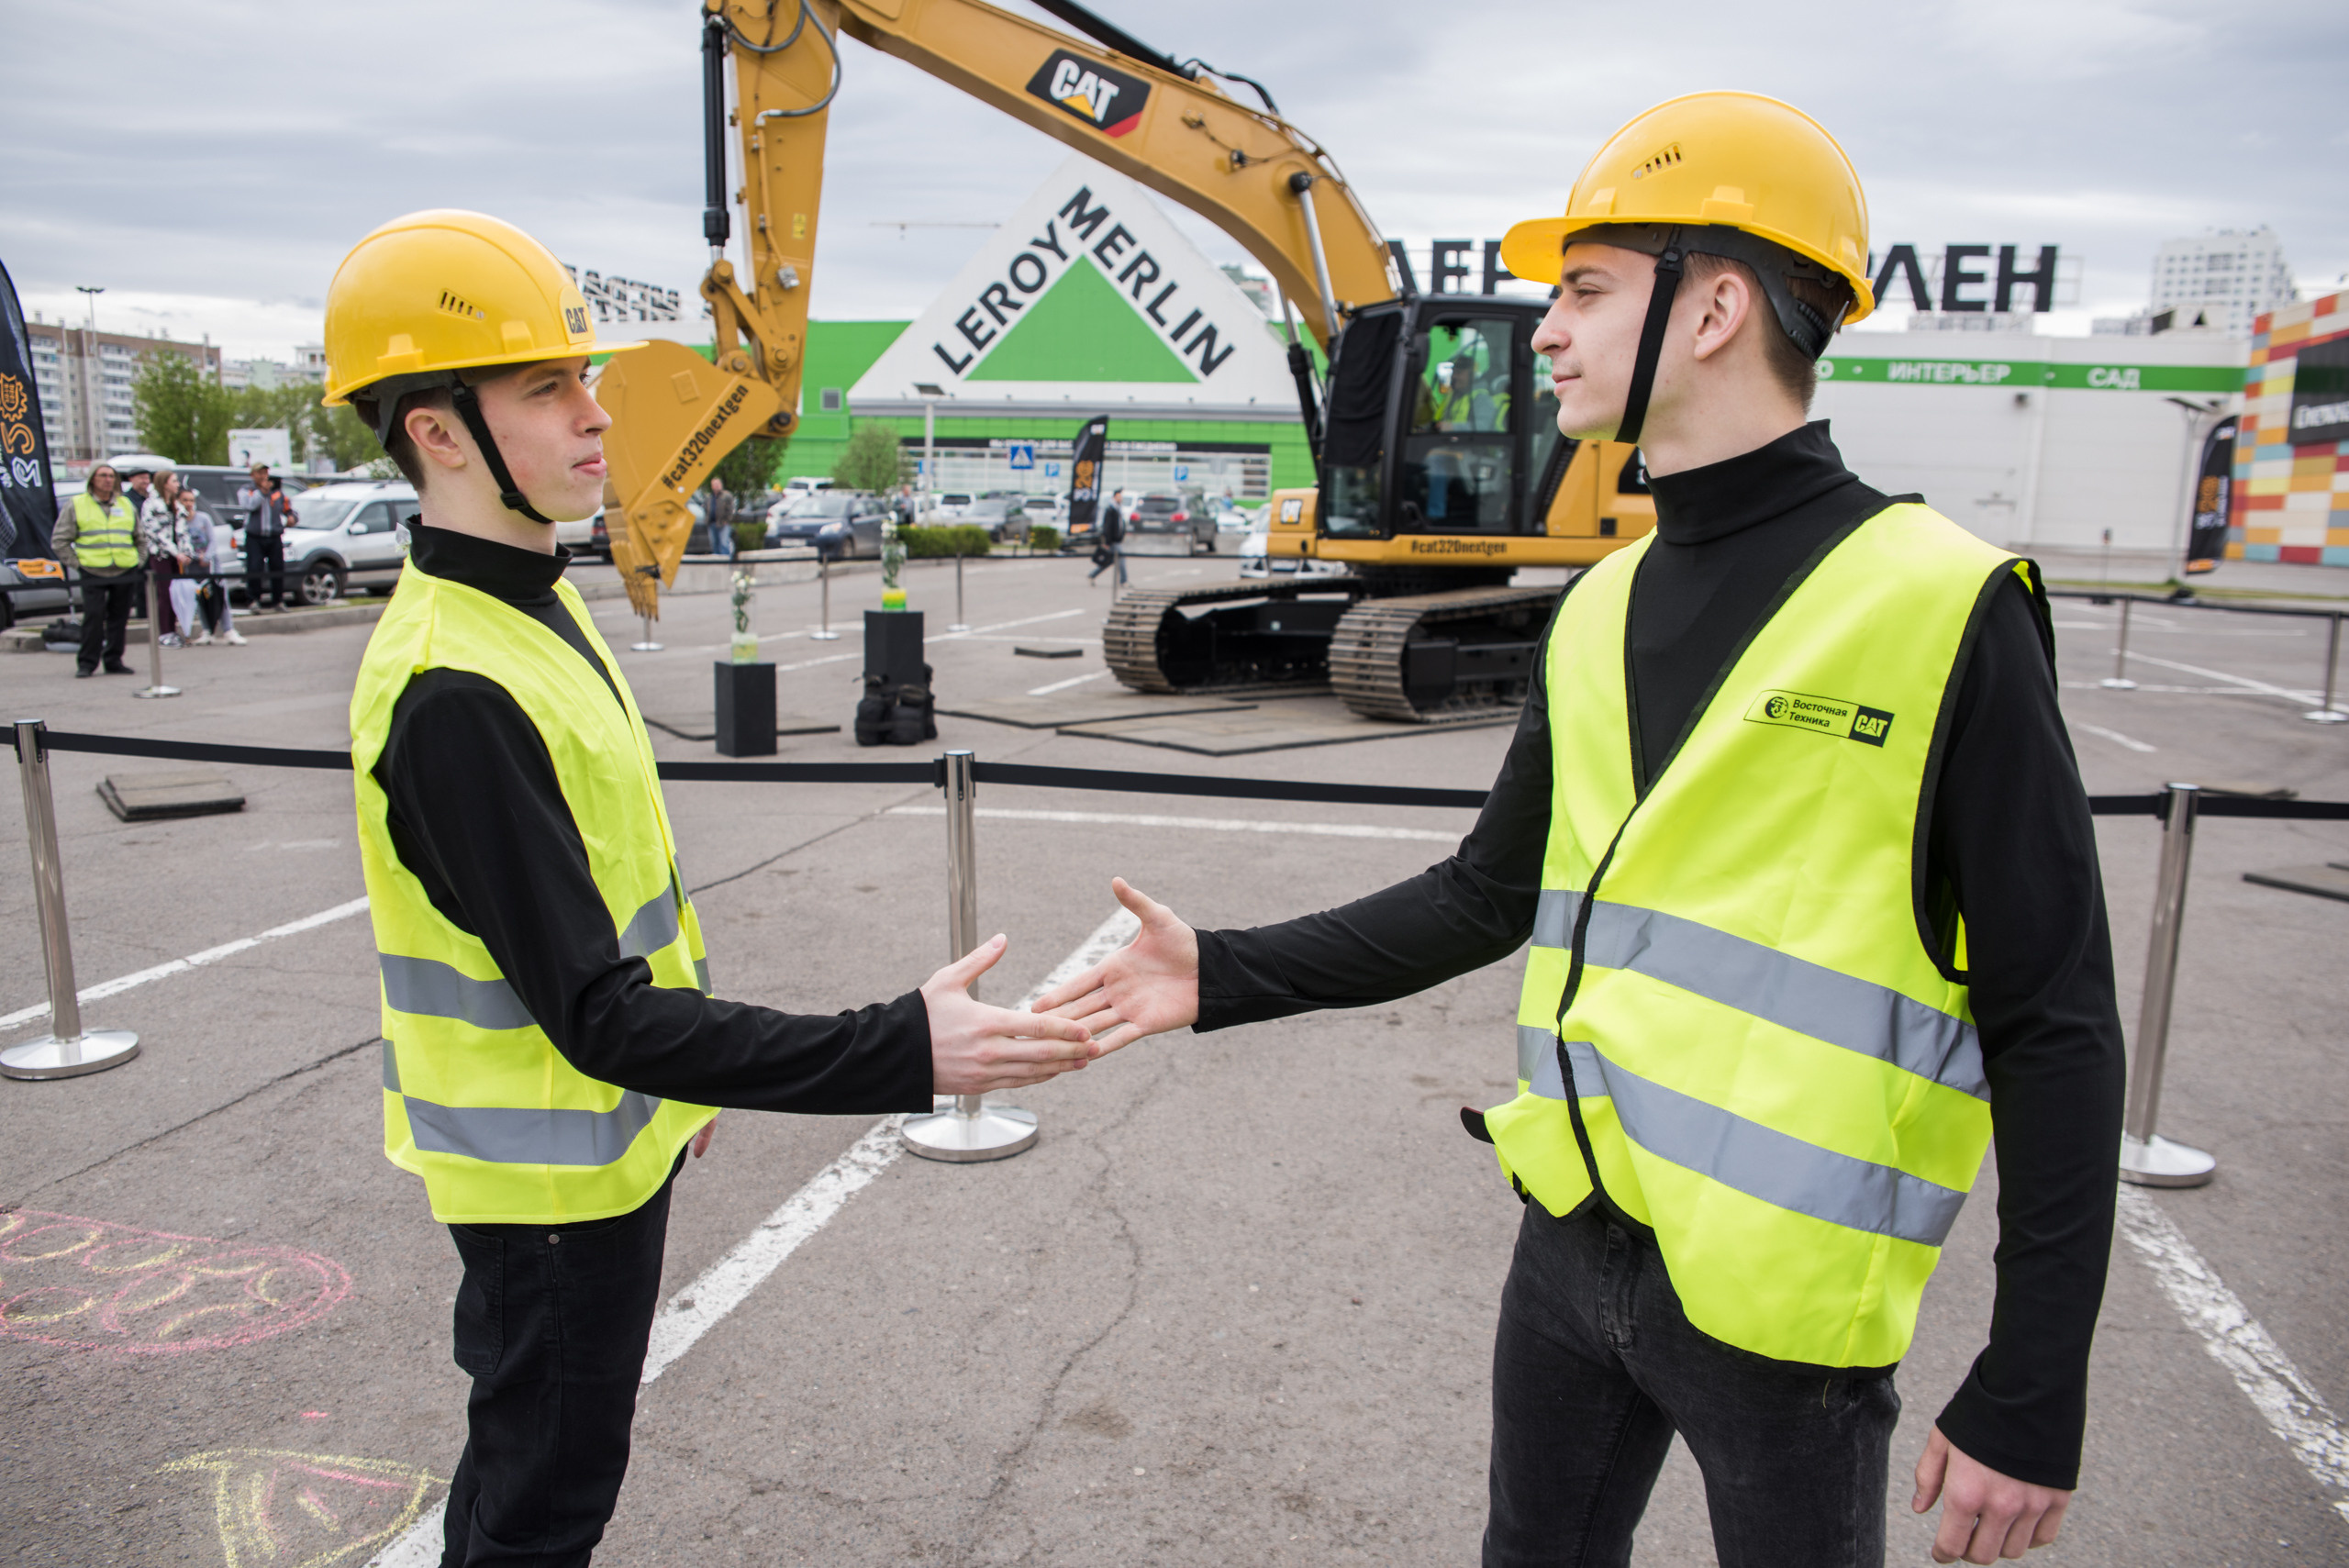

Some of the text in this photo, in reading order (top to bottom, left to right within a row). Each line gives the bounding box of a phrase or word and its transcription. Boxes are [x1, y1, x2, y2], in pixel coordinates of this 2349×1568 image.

[1050, 59, 1119, 123] CAT
[932, 184, 1235, 377] LEROY MERLIN
[1868, 244, 2060, 313] ЛЕН
[565, 306, 588, 334] CAT
[1887, 361, 2011, 384] ИНТЕРЬЕР
[2087, 368, 2141, 389] САД
[661, 384, 749, 491] #cat320nextgen
[1411, 539, 1508, 556] #cat320nextgen
[1789, 711, 1831, 728] Техника
[1792, 699, 1848, 717] Восточная
[1854, 714, 1888, 738] CAT
